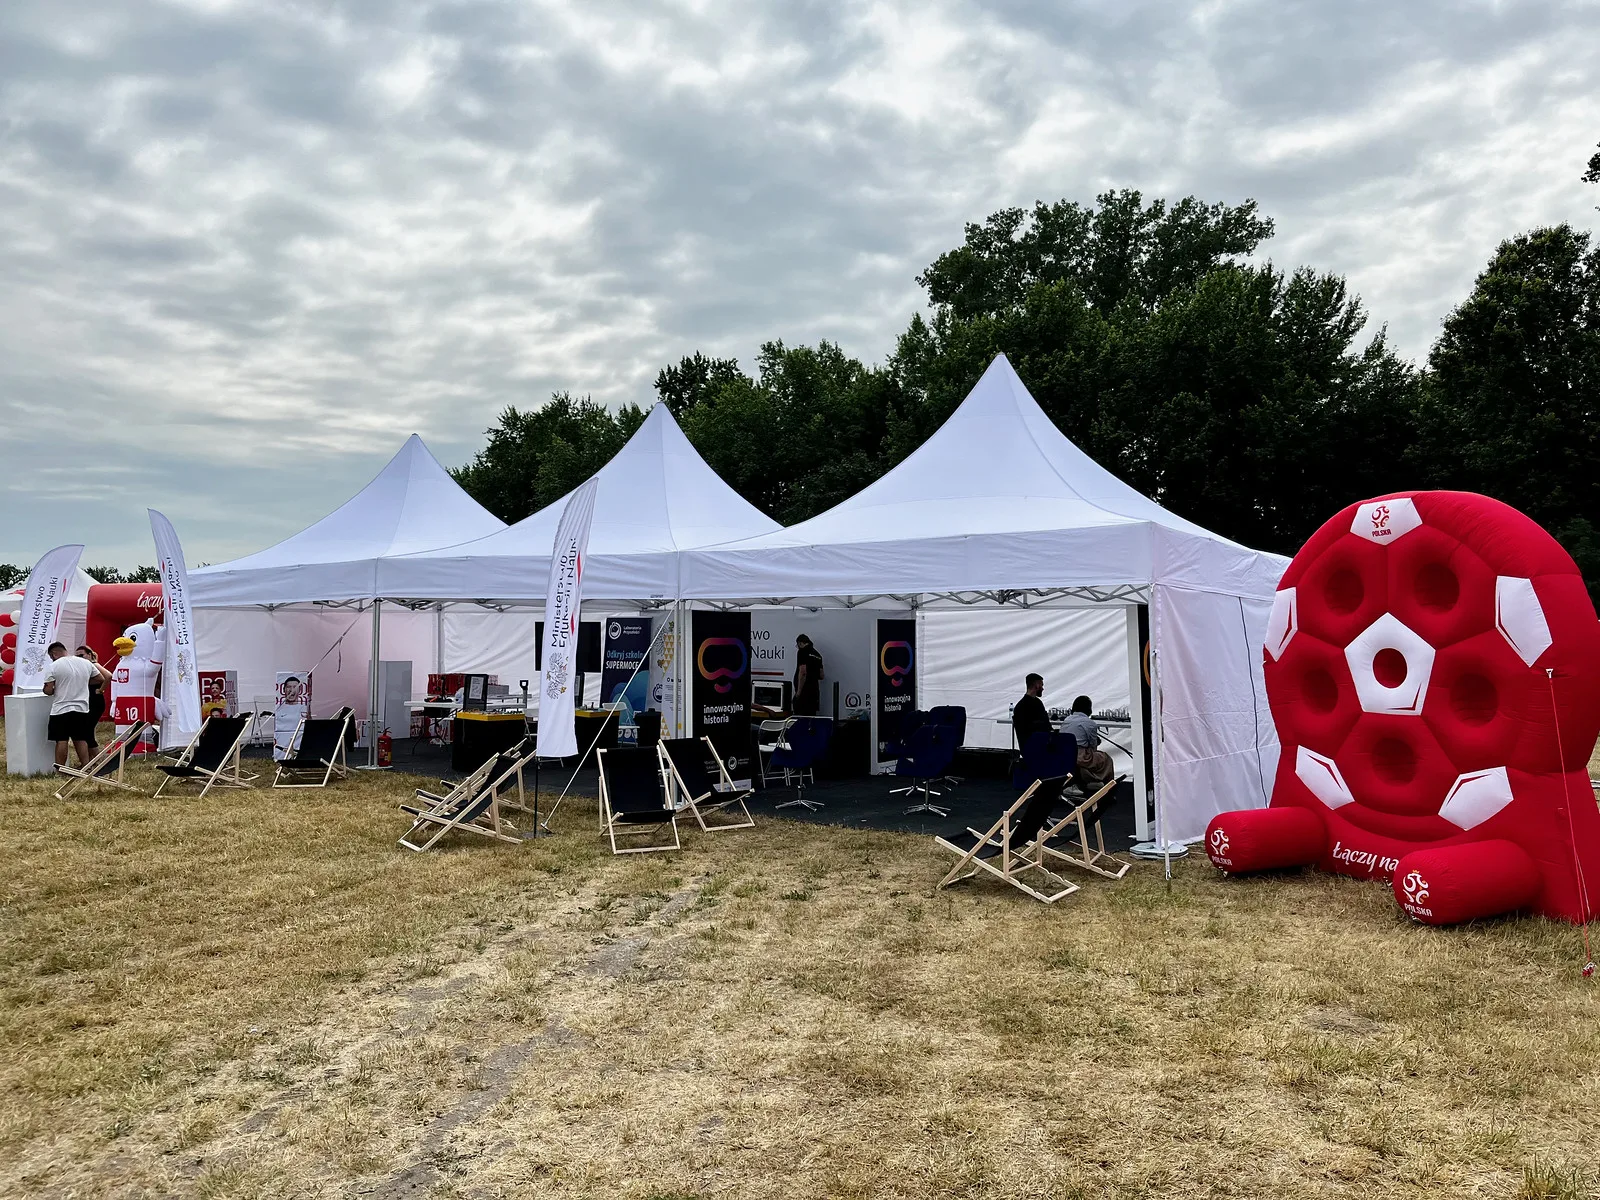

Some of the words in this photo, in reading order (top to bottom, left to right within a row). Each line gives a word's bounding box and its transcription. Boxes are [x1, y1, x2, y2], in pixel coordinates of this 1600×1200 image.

[1371, 529, 1392, 538] POLSKA
[27, 585, 46, 644] Ministerstwo
[38, 608, 54, 645] Edukacji
[46, 576, 58, 602] Nauki
[606, 650, 625, 661] Odkryj
[751, 646, 785, 660] Nauki
[126, 706, 139, 721] 10
[703, 702, 744, 714] innowacyjna
[703, 713, 730, 725] historia
[1211, 855, 1233, 867] POLSKA
[1332, 841, 1378, 873] Łączy
[1378, 857, 1400, 872] na
[1404, 902, 1433, 918] POLSKA
